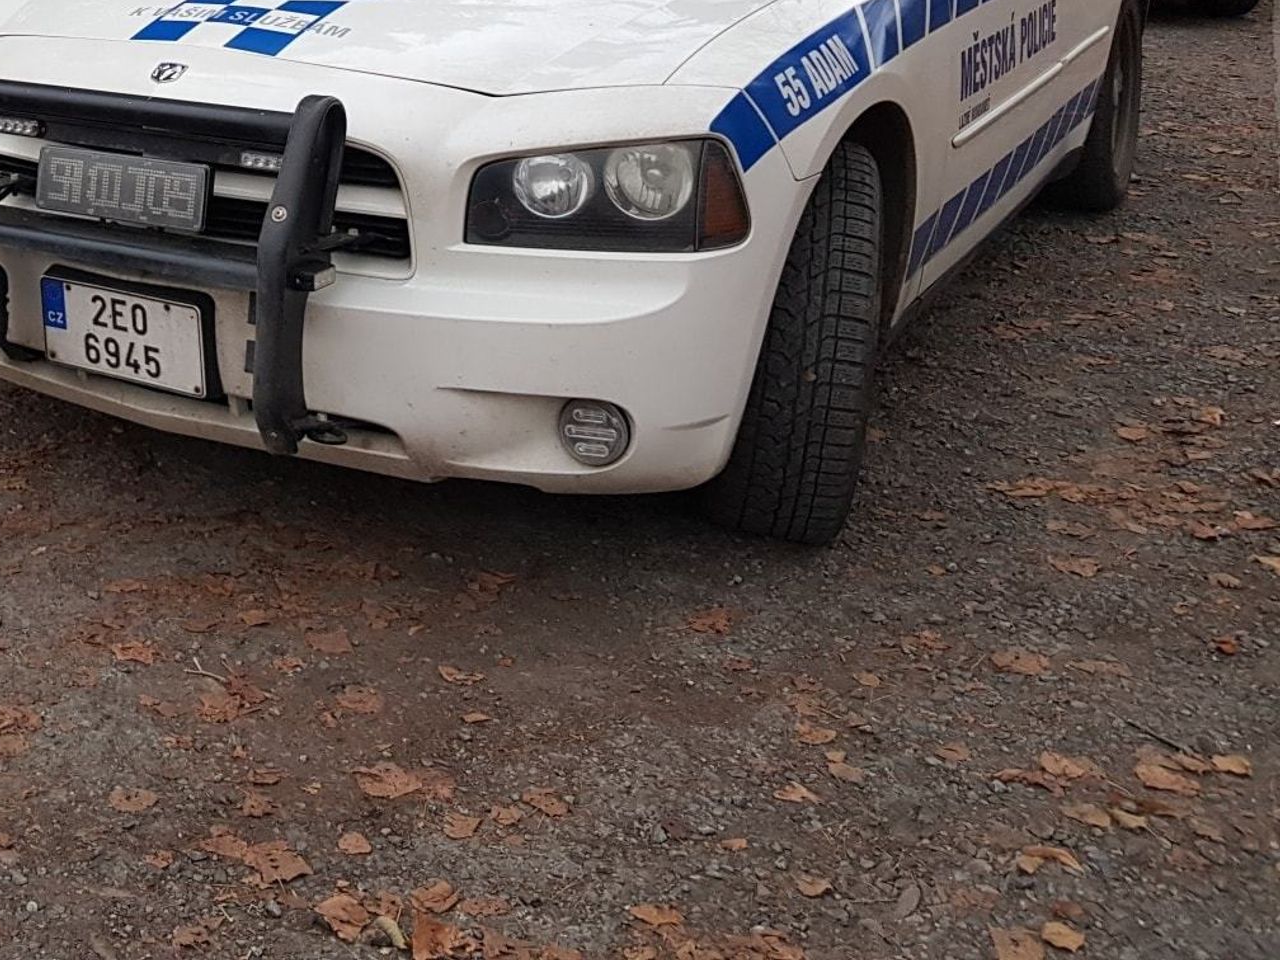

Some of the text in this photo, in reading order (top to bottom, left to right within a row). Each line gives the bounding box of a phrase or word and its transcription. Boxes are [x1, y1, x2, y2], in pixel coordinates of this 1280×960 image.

[129, 4, 352, 38] K VAŠIM SLUŽBÁM
[773, 33, 860, 117] 55 ADAM
[959, 11, 1017, 102] MĚSTSKÁ
[48, 311, 65, 324] CZ
[91, 294, 148, 336] 2E0
[83, 332, 162, 379] 6945
